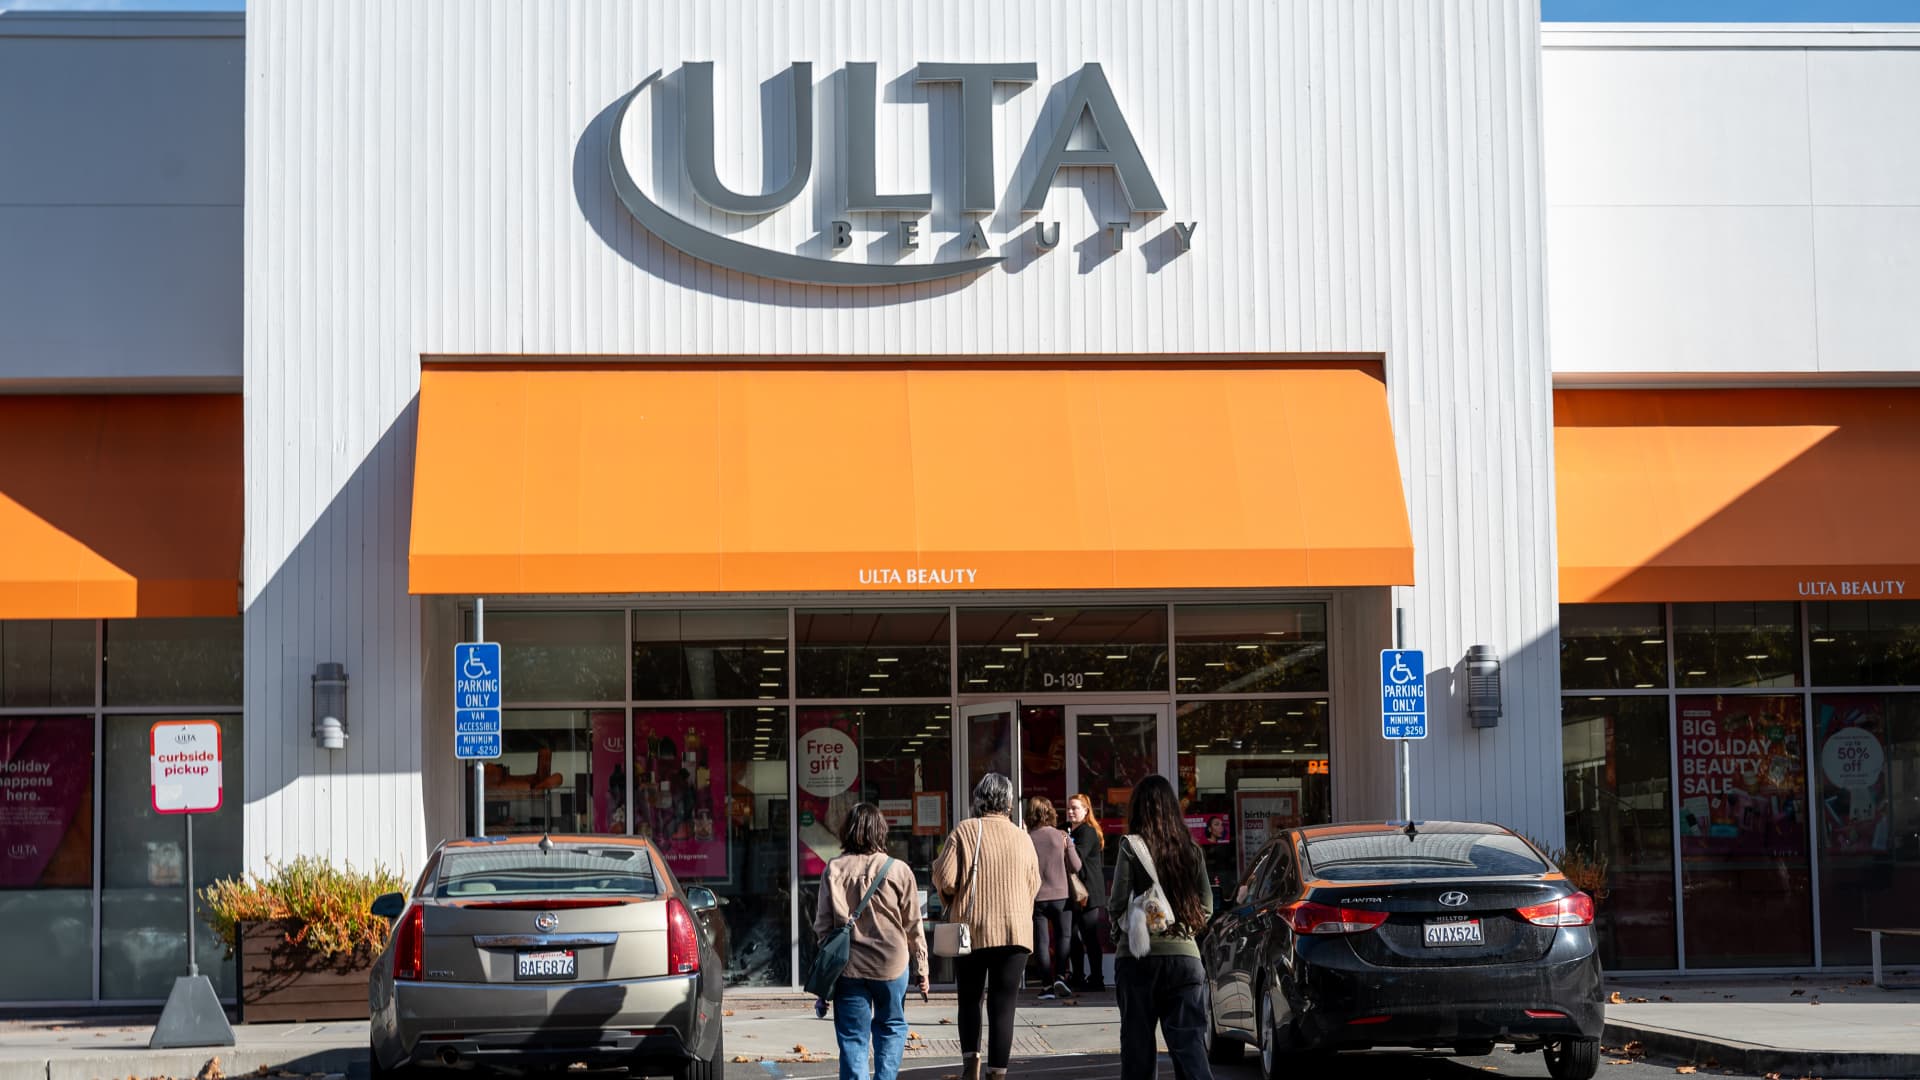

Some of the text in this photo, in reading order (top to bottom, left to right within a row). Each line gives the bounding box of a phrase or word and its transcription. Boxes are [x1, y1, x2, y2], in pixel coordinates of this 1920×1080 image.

[682, 61, 1168, 216] ULTA
[831, 220, 1198, 251] BEAUTY
[859, 568, 977, 584] ULTA BEAUTY
[1798, 580, 1905, 596] ULTA BEAUTY
[457, 679, 498, 693] PARKING
[1043, 672, 1084, 687] D-130
[1384, 684, 1424, 698] PARKING
[465, 693, 490, 707] ONLY
[1392, 698, 1417, 712] ONLY
[471, 712, 485, 721] VAN
[1389, 716, 1419, 725] MINIMUM
[458, 722, 498, 731] ACCESSIBLE
[1386, 726, 1424, 736] FINE $250
[1682, 719, 1717, 736] BIG
[463, 735, 494, 744] MINIMUM
[1682, 737, 1772, 756] HOLIDAY
[458, 745, 498, 755] FINE $250
[806, 739, 844, 755] Free
[1837, 747, 1870, 760] 50%
[158, 750, 215, 763] curbside
[164, 764, 209, 778] pickup
[1682, 758, 1763, 775] BEAUTY
[1843, 760, 1862, 772] off
[1683, 778, 1734, 795] SALE
[6, 788, 41, 801] here.
[1427, 926, 1479, 942] 6VAX524
[520, 960, 574, 975] 8AEG876
